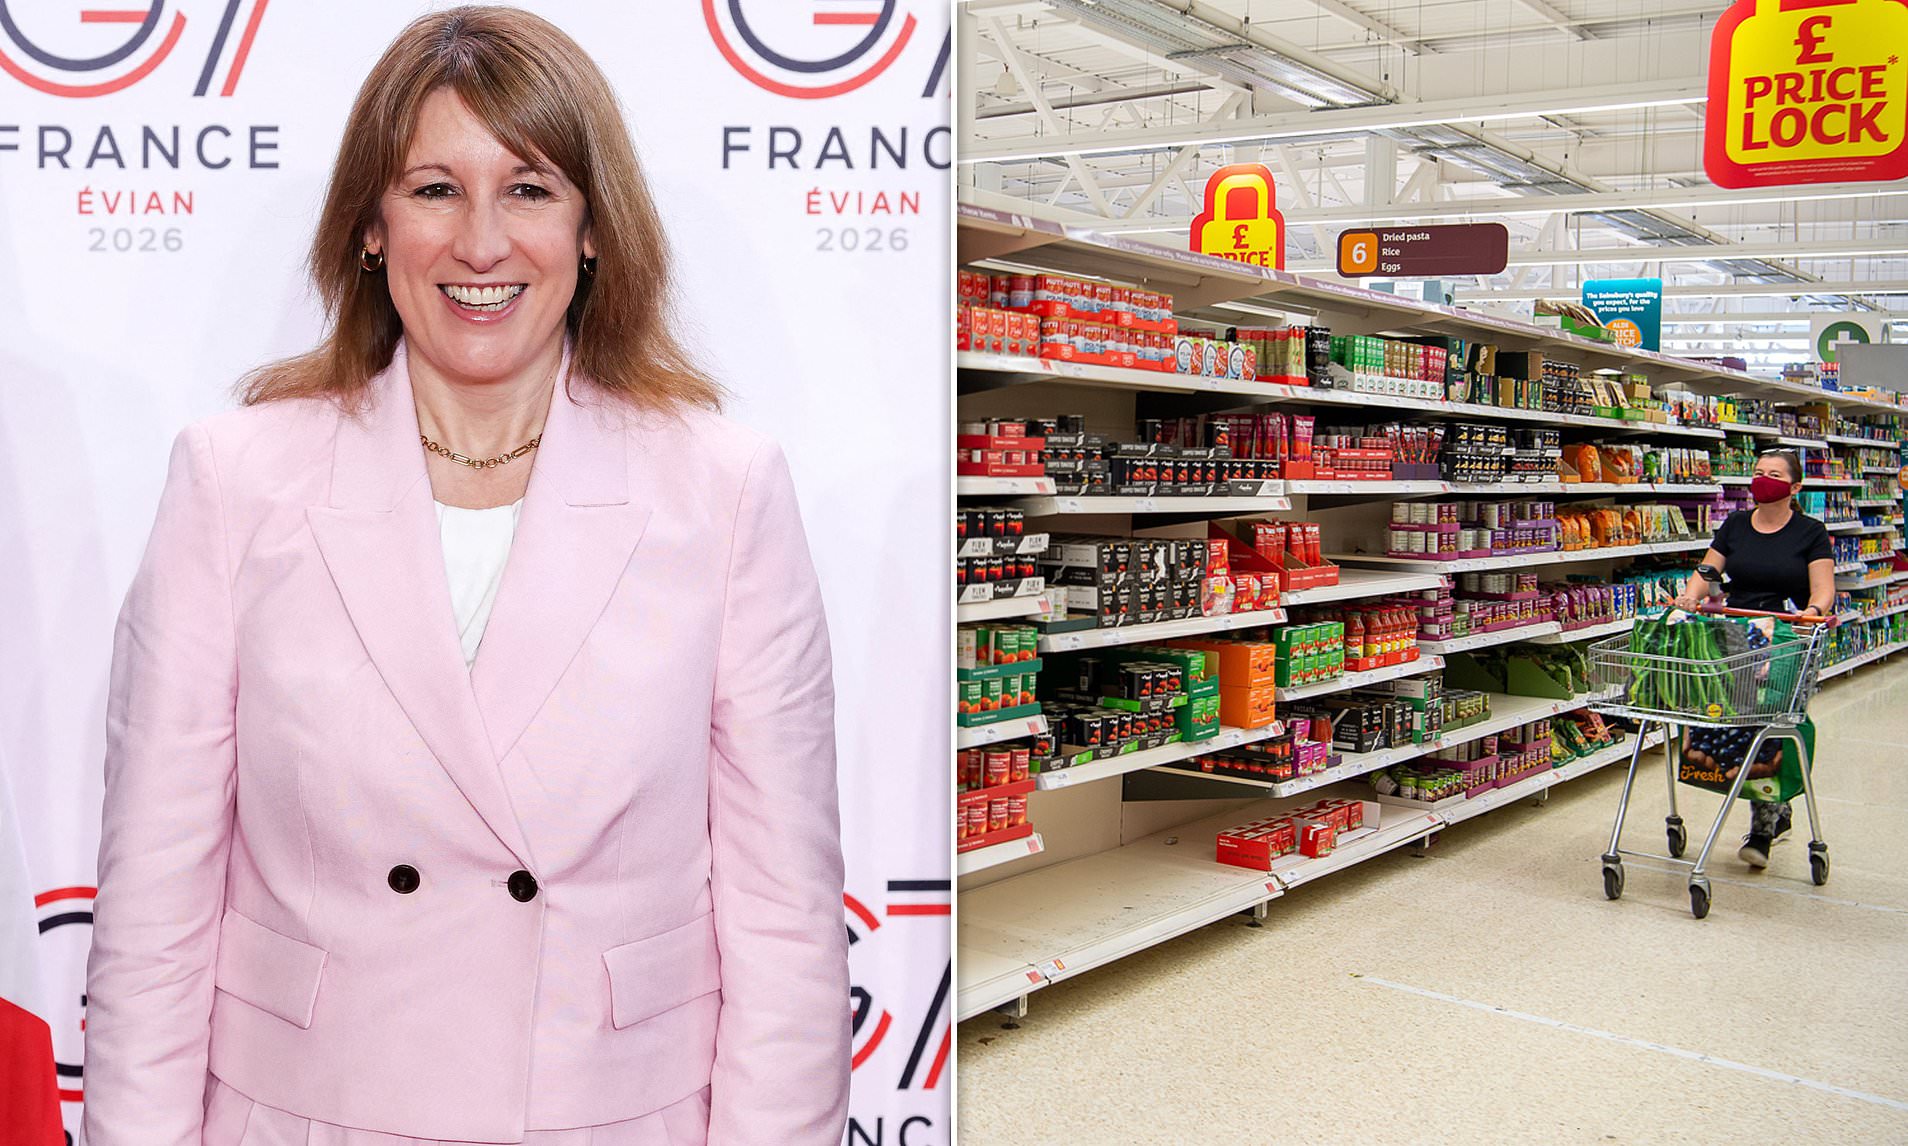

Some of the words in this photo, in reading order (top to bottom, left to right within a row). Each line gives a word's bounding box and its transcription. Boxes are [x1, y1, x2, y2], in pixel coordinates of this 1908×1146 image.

[1742, 101, 1889, 151] LOCK
[78, 186, 194, 215] ÉVIAN
[806, 187, 920, 215] ÉVIAN
[88, 227, 184, 252] 2026
[816, 227, 909, 252] 2026
[1383, 233, 1405, 242] Dried
[1406, 232, 1430, 243] pasta
[1352, 242, 1367, 265] 6
[1382, 248, 1401, 256] Rice
[1381, 262, 1401, 272] Eggs
[1614, 329, 1636, 338] RICE
[1680, 764, 1726, 783] Fresh
